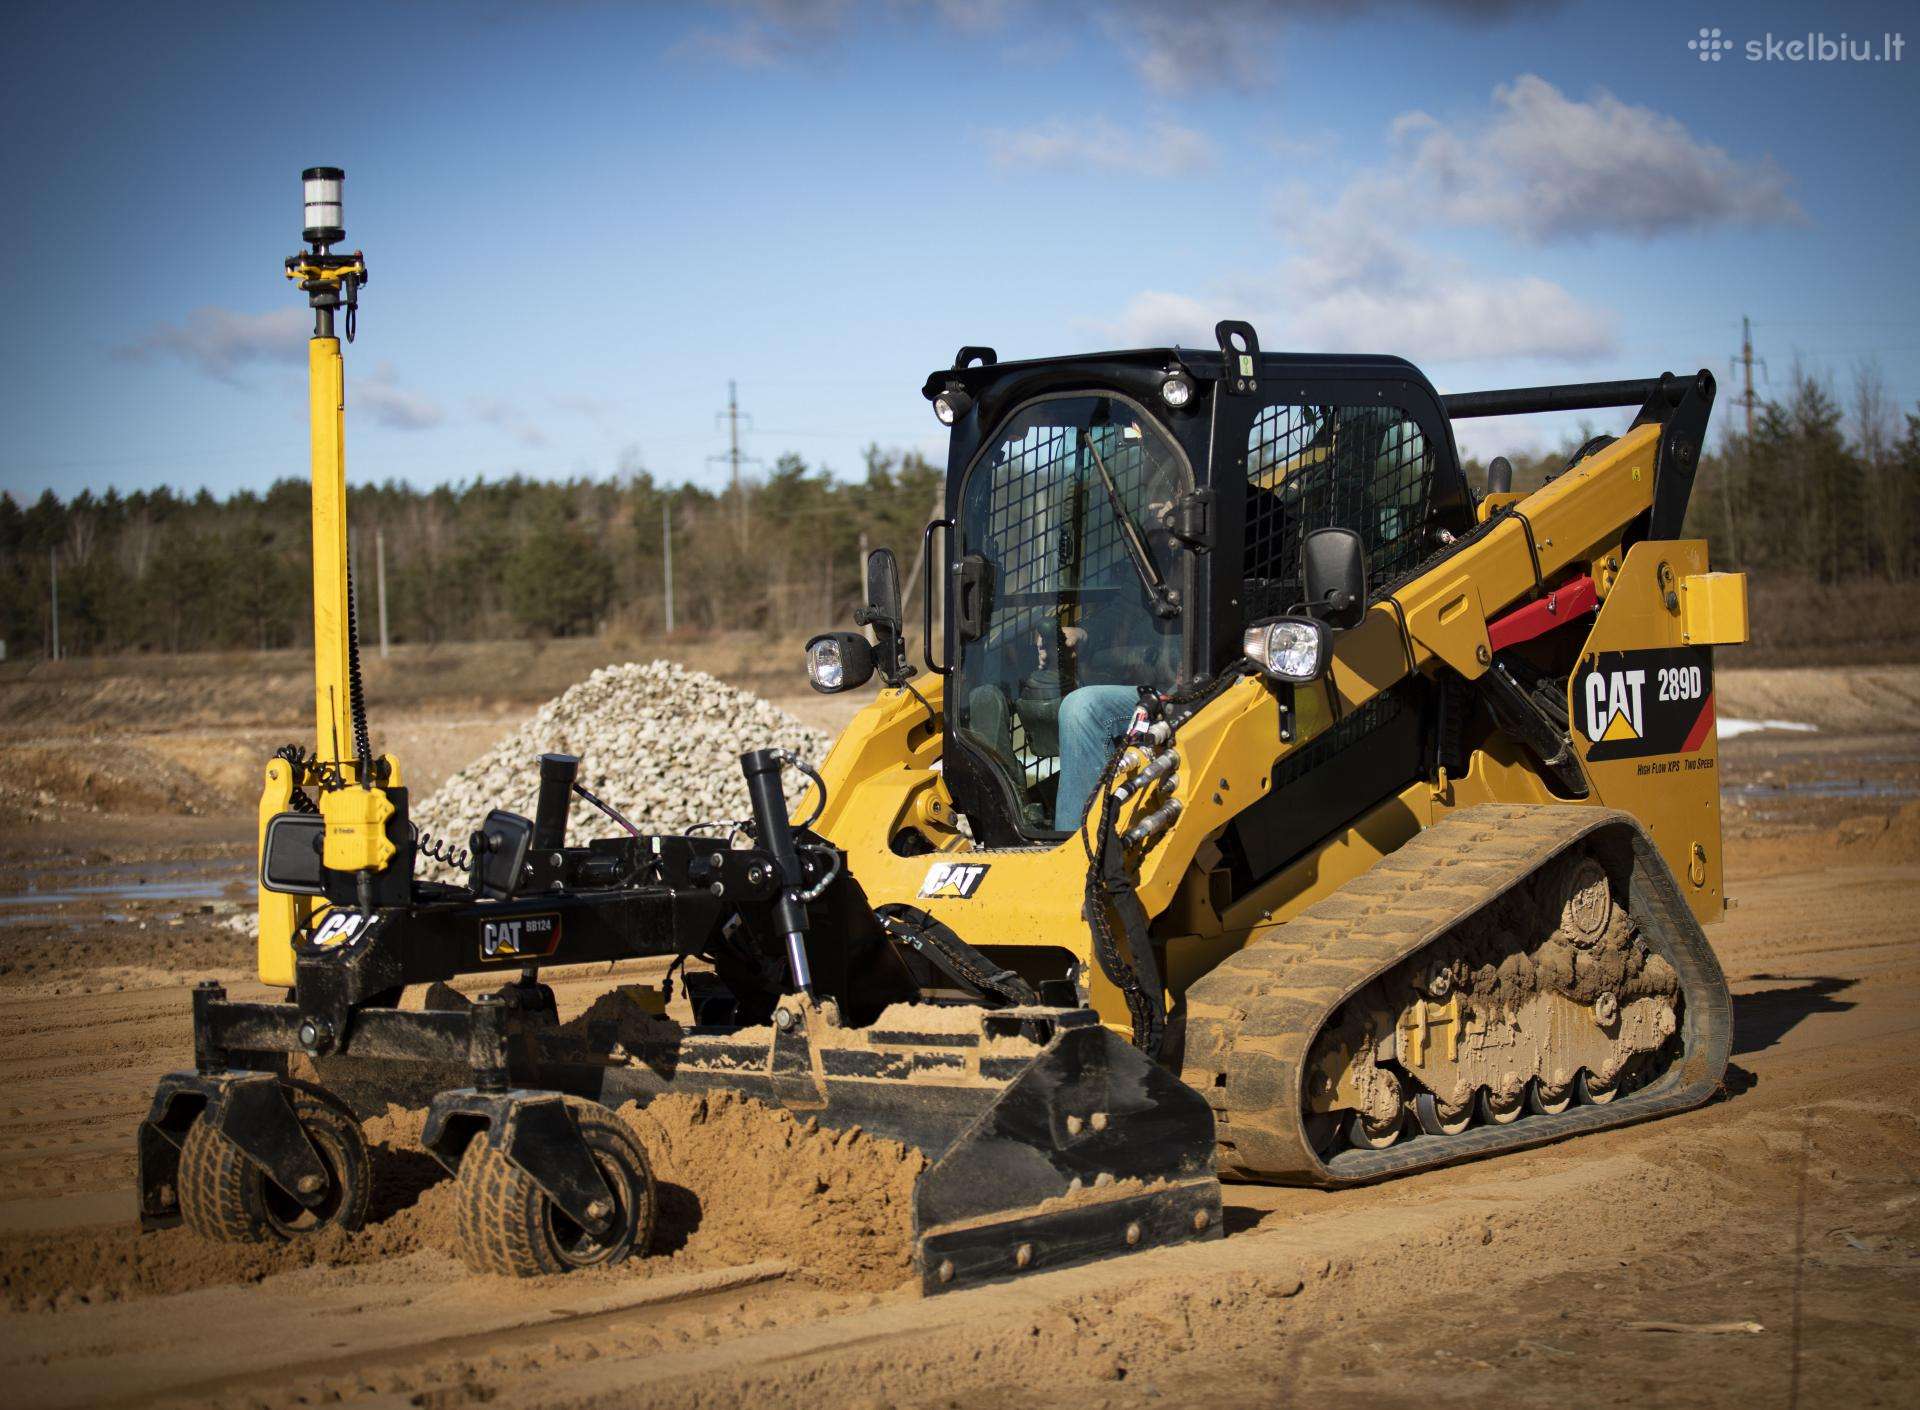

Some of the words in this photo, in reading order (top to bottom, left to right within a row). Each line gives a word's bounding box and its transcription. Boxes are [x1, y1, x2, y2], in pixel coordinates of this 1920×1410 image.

[1585, 670, 1646, 742] CAT
[1657, 666, 1702, 701] 289D
[1667, 760, 1680, 772] XPS
[1697, 758, 1714, 769] SPEED
[923, 863, 983, 896] CAT
[484, 921, 522, 955] CAT
